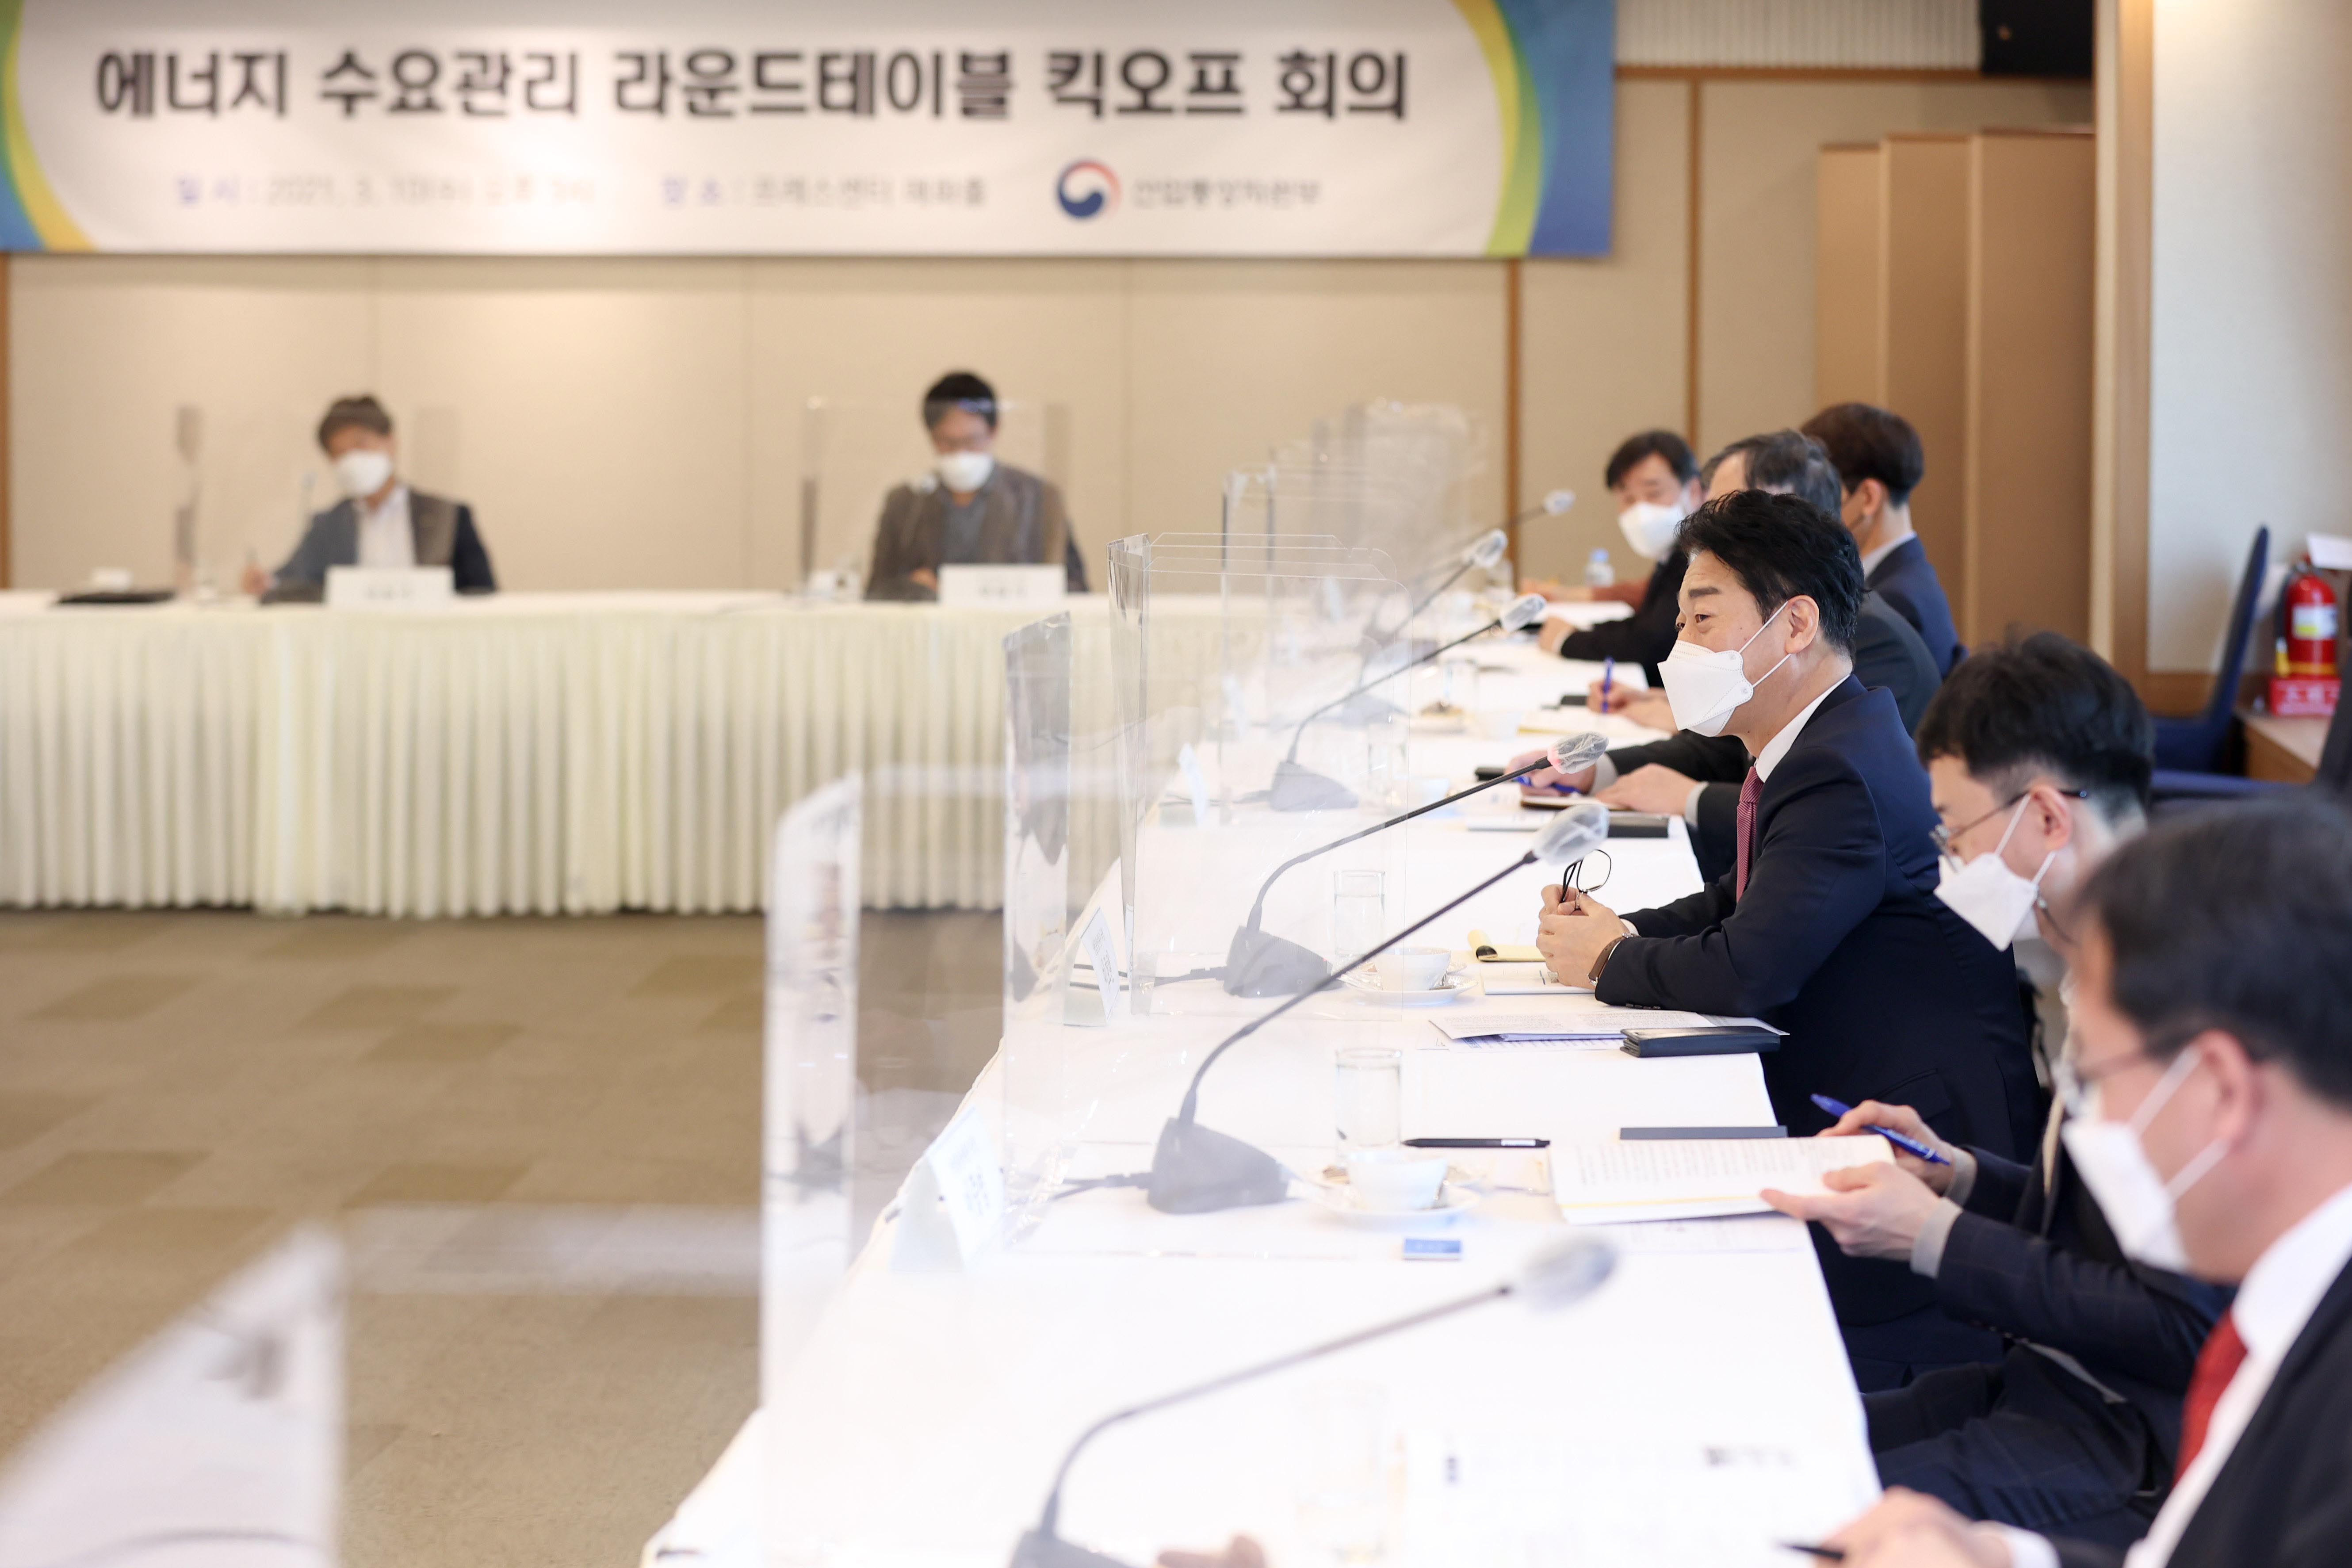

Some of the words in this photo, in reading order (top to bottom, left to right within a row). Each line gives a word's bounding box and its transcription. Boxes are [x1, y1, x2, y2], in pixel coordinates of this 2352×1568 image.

[94, 49, 289, 117] 에너지
[319, 49, 578, 117] 수요관리
[615, 50, 1013, 118] 라운드테이블
[1046, 49, 1246, 118] 킥오프
[1276, 49, 1408, 120] 회의
